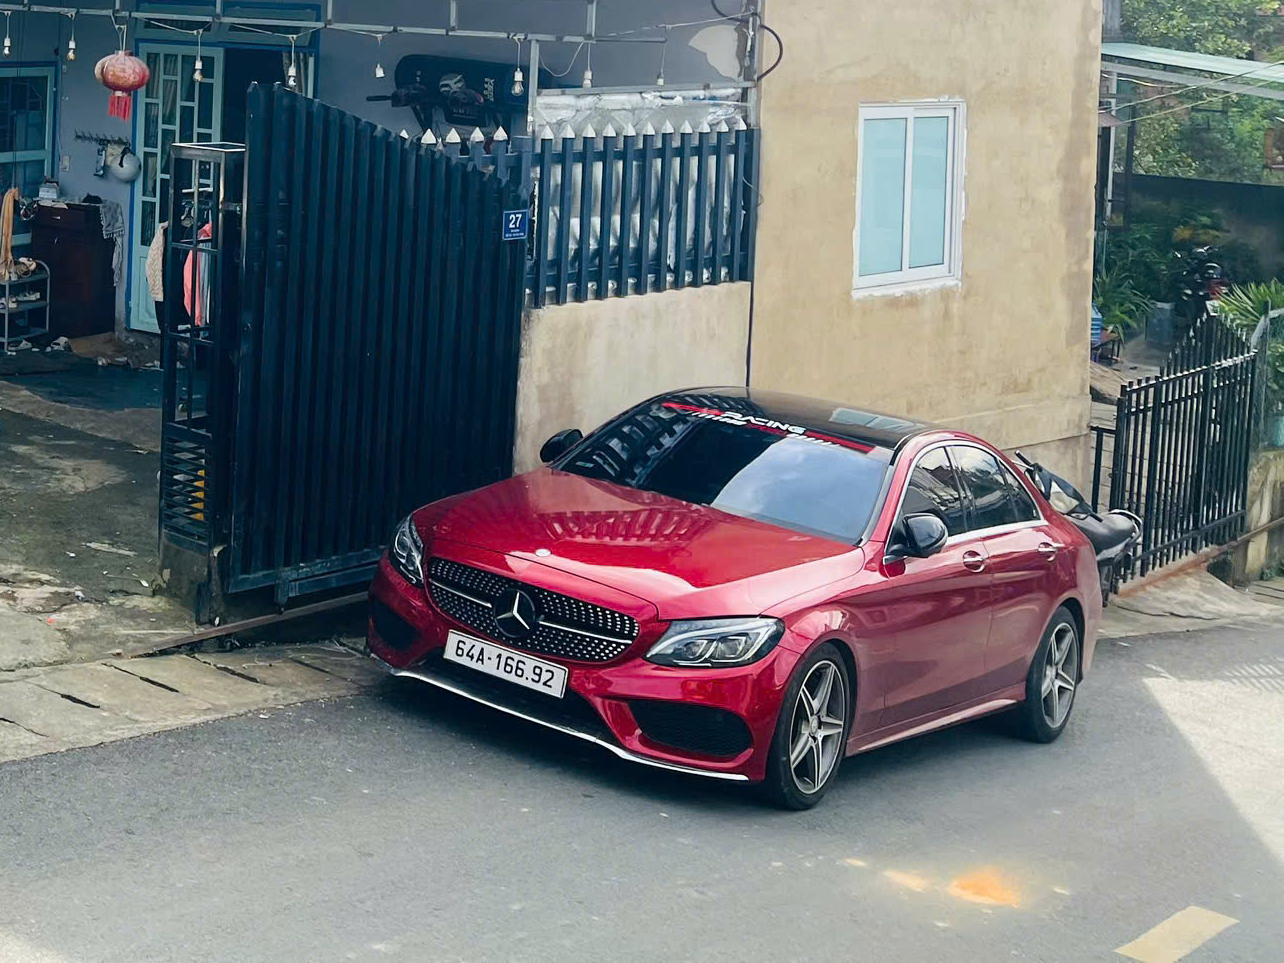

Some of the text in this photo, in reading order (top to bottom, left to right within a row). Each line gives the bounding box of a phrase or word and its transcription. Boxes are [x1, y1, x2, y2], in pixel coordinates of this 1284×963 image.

[509, 213, 522, 228] 27
[721, 411, 806, 435] RACING
[455, 640, 555, 689] 64A-166.92
